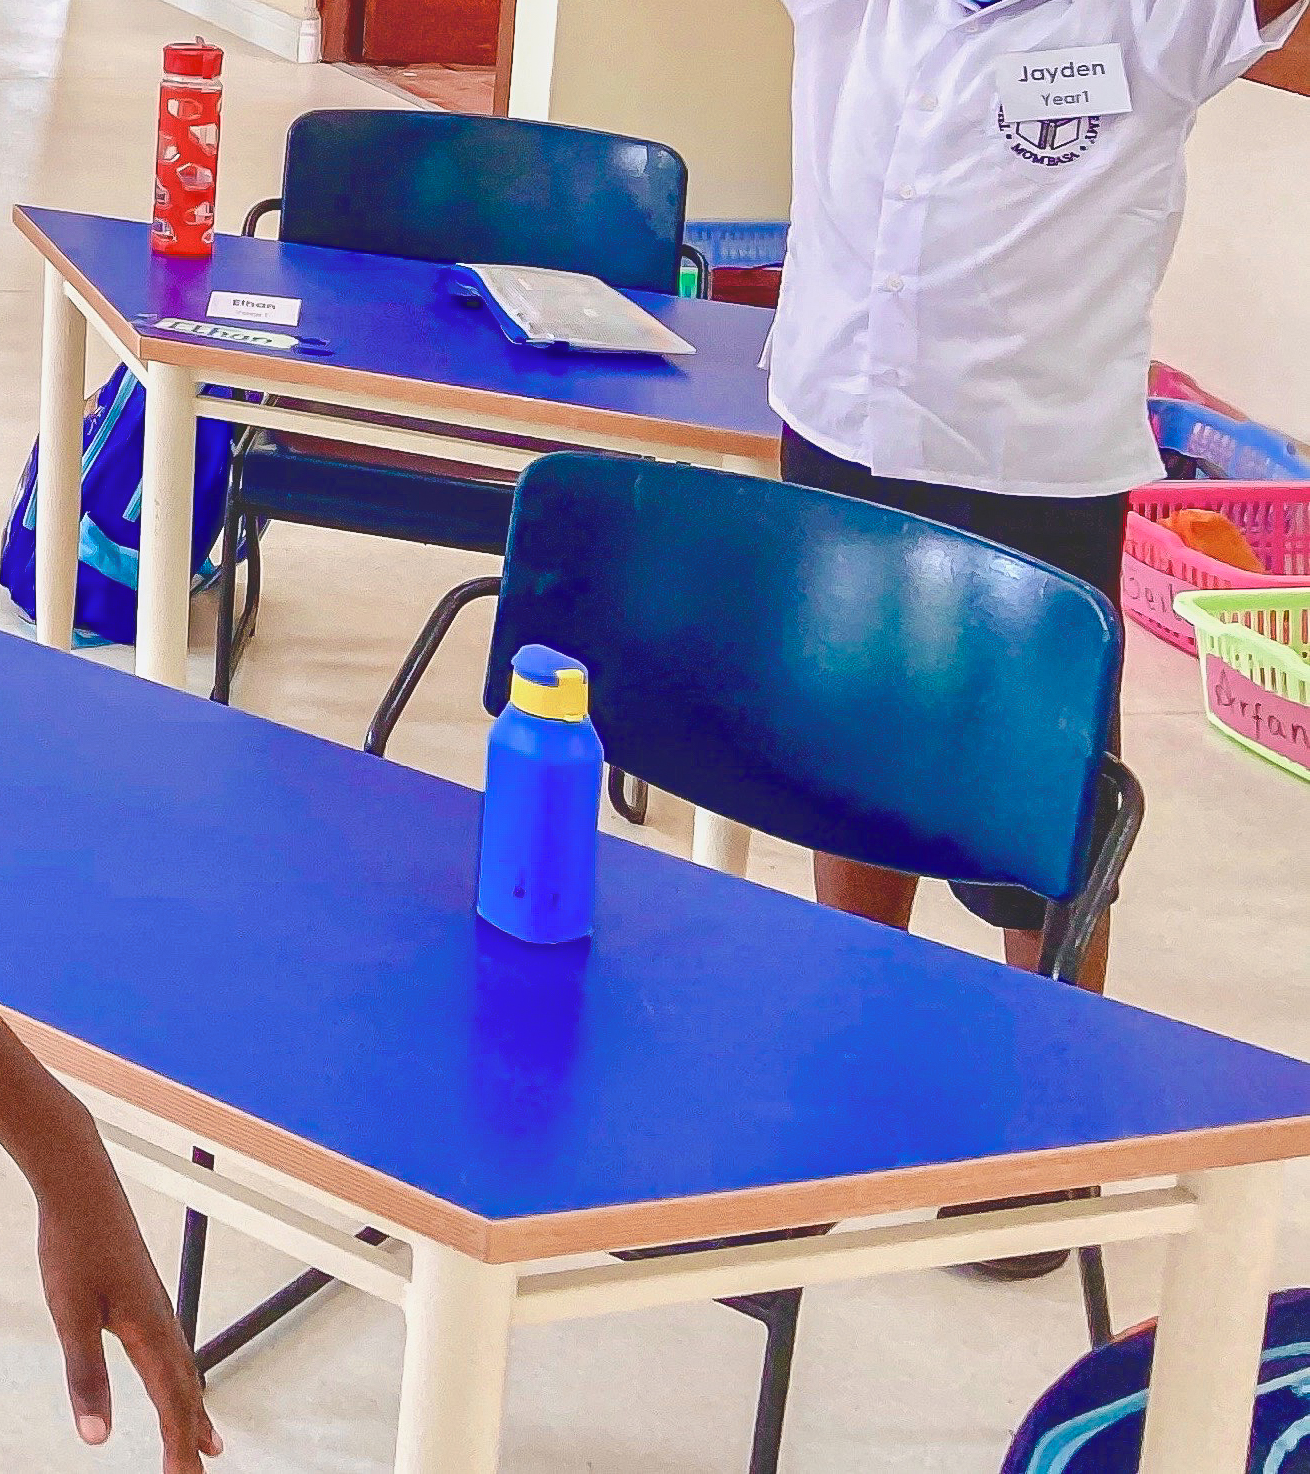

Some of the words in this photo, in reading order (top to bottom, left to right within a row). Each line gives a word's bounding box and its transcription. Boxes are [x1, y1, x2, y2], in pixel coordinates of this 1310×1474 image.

[1017, 61, 1106, 84] Jayden
[1041, 90, 1090, 107] Year1
[1011, 142, 1081, 167] MOMBASA
